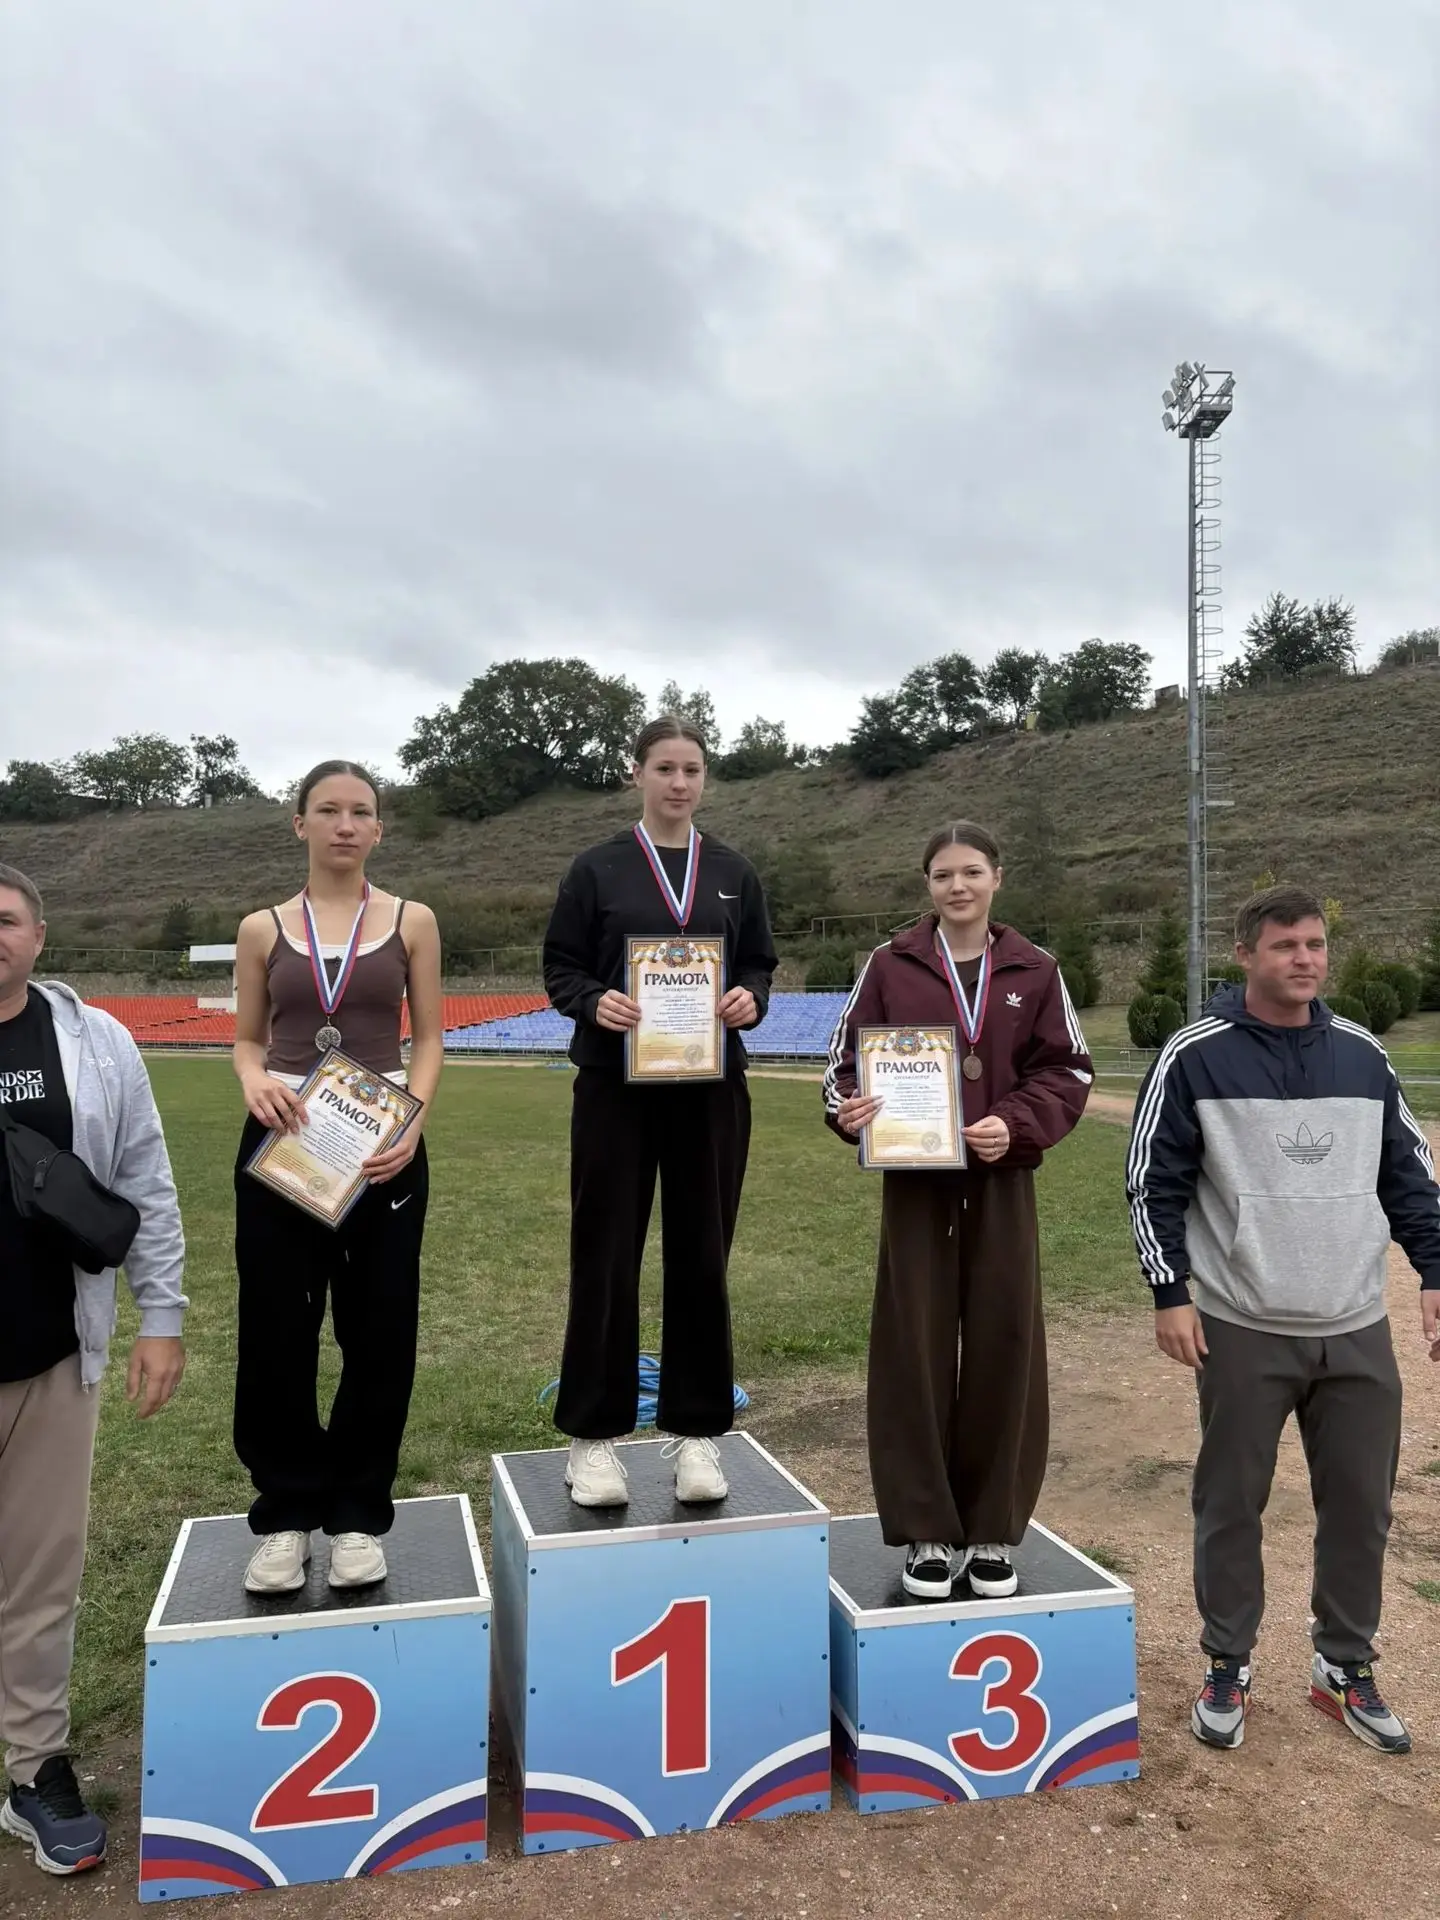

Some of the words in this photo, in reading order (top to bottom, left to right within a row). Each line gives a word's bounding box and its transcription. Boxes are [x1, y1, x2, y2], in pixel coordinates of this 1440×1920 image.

[645, 973, 709, 985] ГРАМОТА
[876, 1061, 942, 1073] ГРАМОТА
[15, 1083, 45, 1101] DIE
[318, 1088, 381, 1136] ГРАМОТА
[610, 1595, 711, 1778] 1
[947, 1630, 1051, 1776] 3
[249, 1671, 381, 1833] 2
